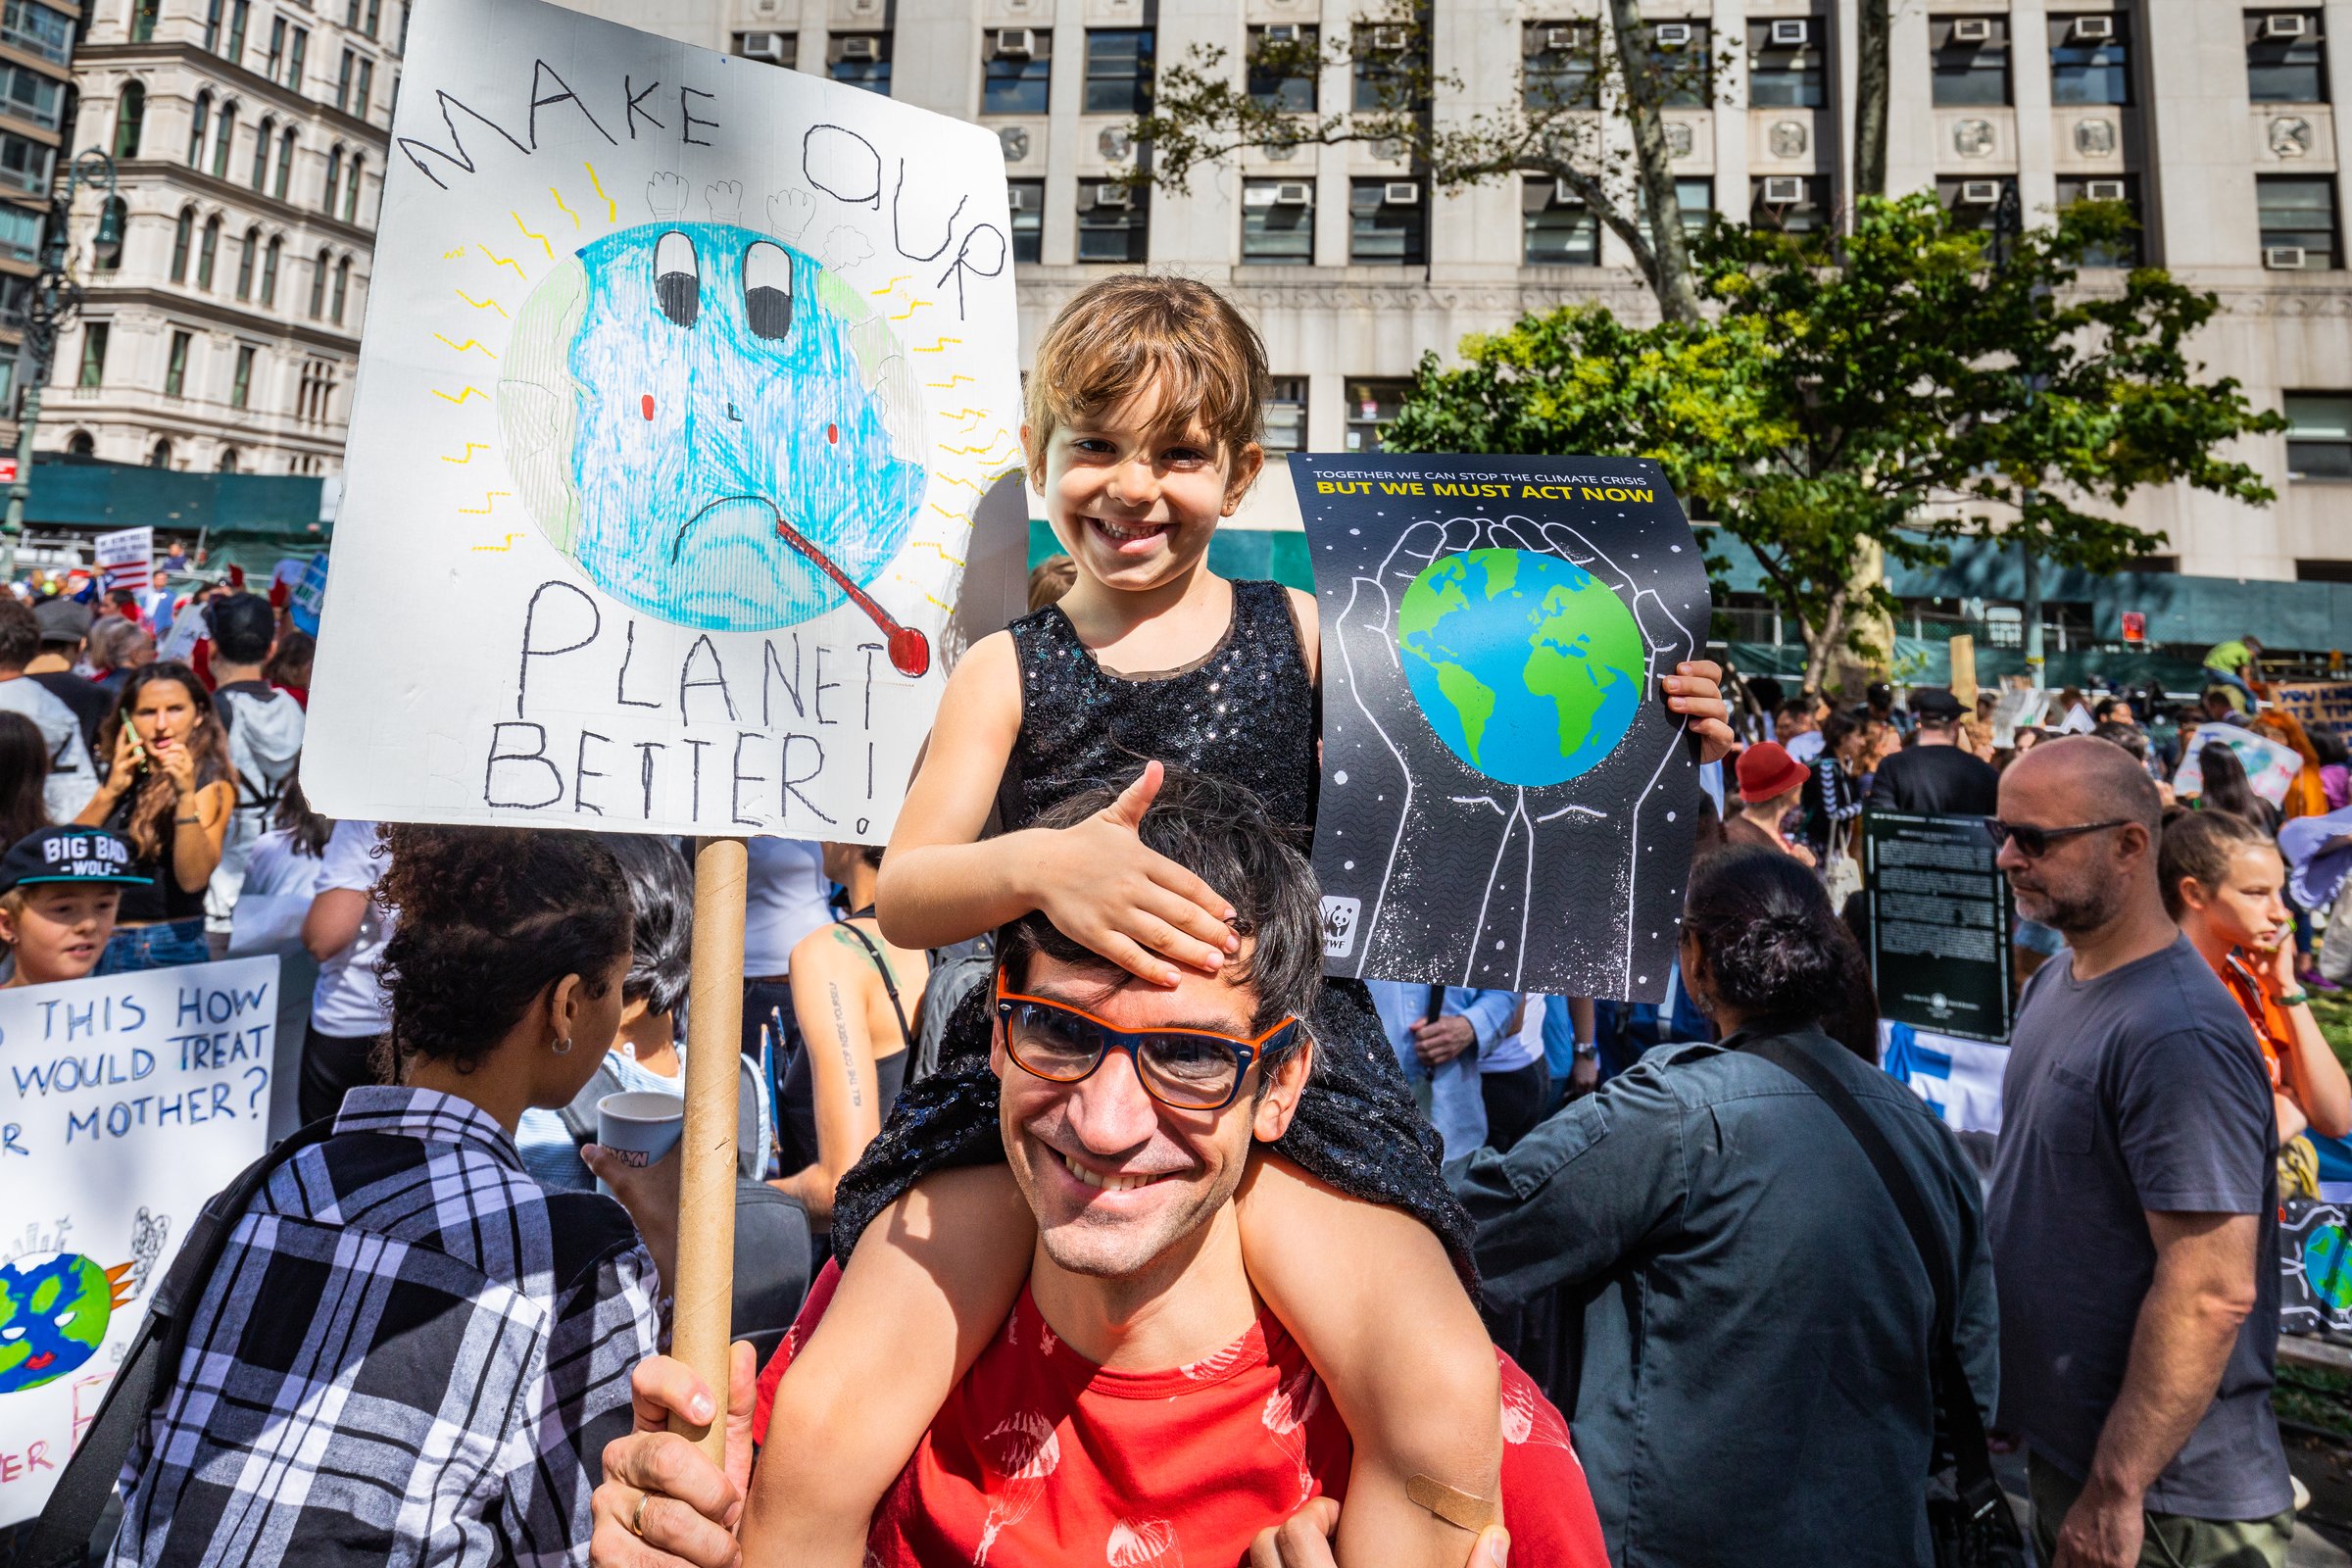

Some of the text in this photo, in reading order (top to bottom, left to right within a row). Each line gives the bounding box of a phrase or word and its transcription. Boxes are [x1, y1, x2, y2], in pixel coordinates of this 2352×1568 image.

[397, 59, 719, 190] MAKE
[1313, 470, 1394, 479] TOGETHER
[1396, 471, 1421, 480] WE
[1459, 472, 1497, 481] STOP
[1501, 473, 1531, 482] THE
[1535, 474, 1598, 484] CLIMATE
[1601, 476, 1647, 485] CRISIS
[1316, 481, 1654, 503] BUT WE MUST ACT NOW
[516, 579, 885, 728] PLANET
[2278, 690, 2315, 703] YOU
[483, 721, 880, 835] BETTER!
[43, 836, 129, 863] BIG BAD
[1328, 940, 1347, 950] WF
[37, 995, 146, 1042] THIS
[176, 983, 268, 1028] HOW
[12, 1024, 270, 1099] WOULD TREAT
[66, 1065, 269, 1145] MOTHER?
